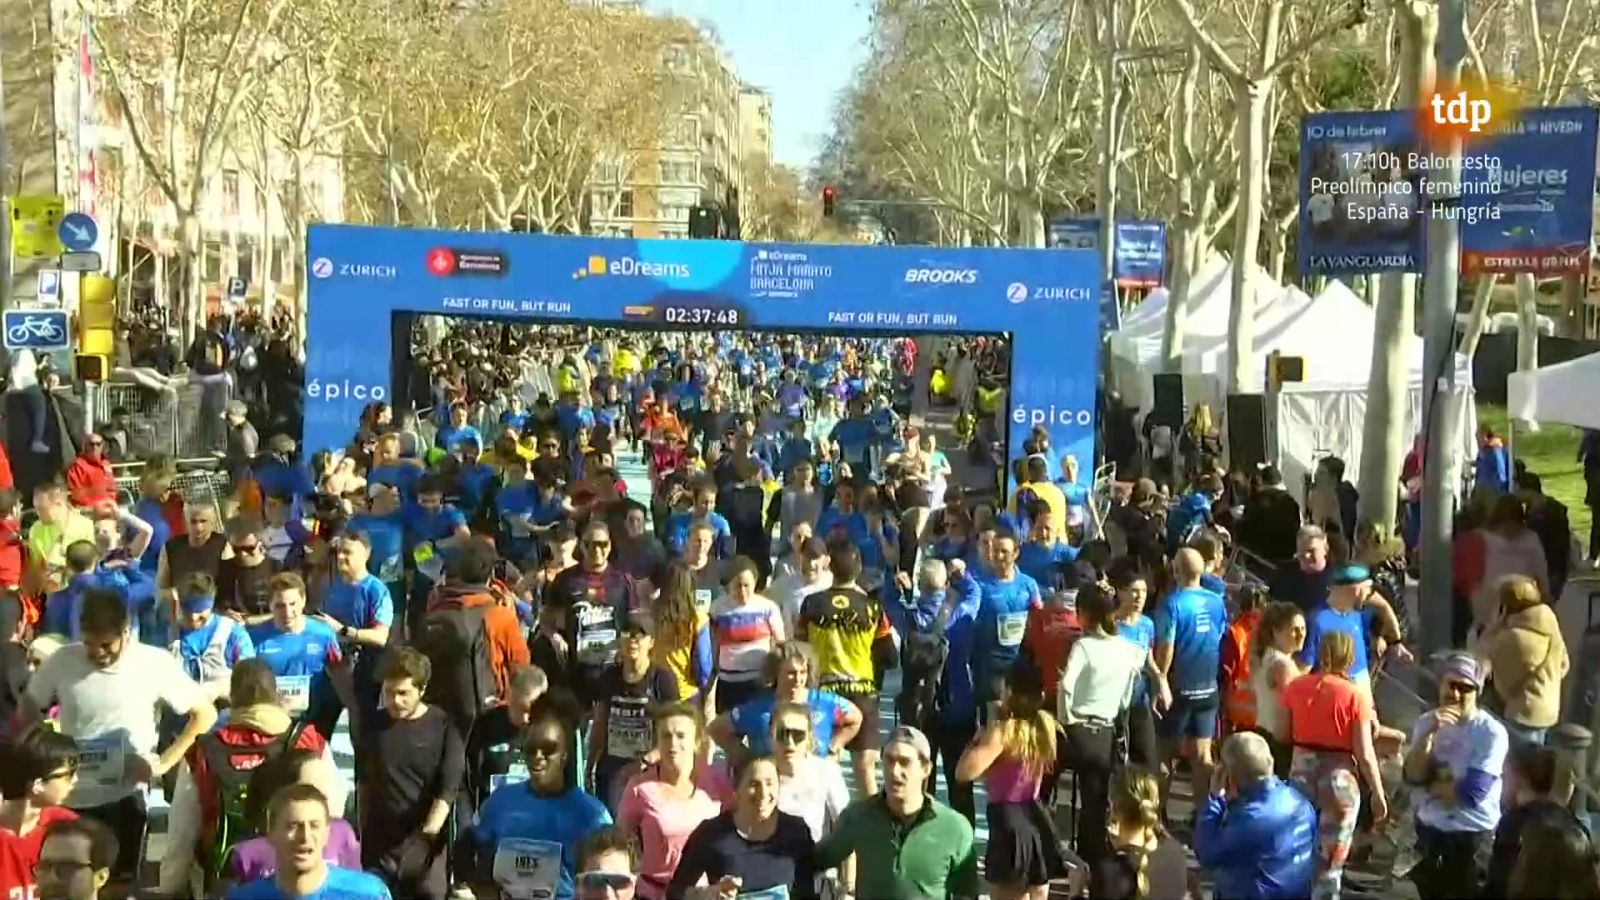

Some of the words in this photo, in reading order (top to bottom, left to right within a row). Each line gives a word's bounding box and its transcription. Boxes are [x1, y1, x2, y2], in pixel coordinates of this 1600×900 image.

[609, 257, 690, 277] eDreams
[1327, 254, 1414, 269] VANGUARDIA
[340, 263, 396, 277] ZURICH
[904, 269, 978, 284] BROOKS
[231, 279, 244, 293] P
[1033, 287, 1091, 300] ZURICH
[443, 297, 471, 309] FAST
[472, 299, 489, 309] OR
[521, 301, 545, 311] BUT
[547, 302, 571, 313] RUN
[666, 307, 738, 324] 02:37:48
[828, 311, 855, 323] FAST
[858, 313, 874, 322] OR
[907, 314, 929, 325] BUT
[933, 315, 957, 325] RUN
[307, 378, 385, 402] épico
[1013, 403, 1091, 428] épico
